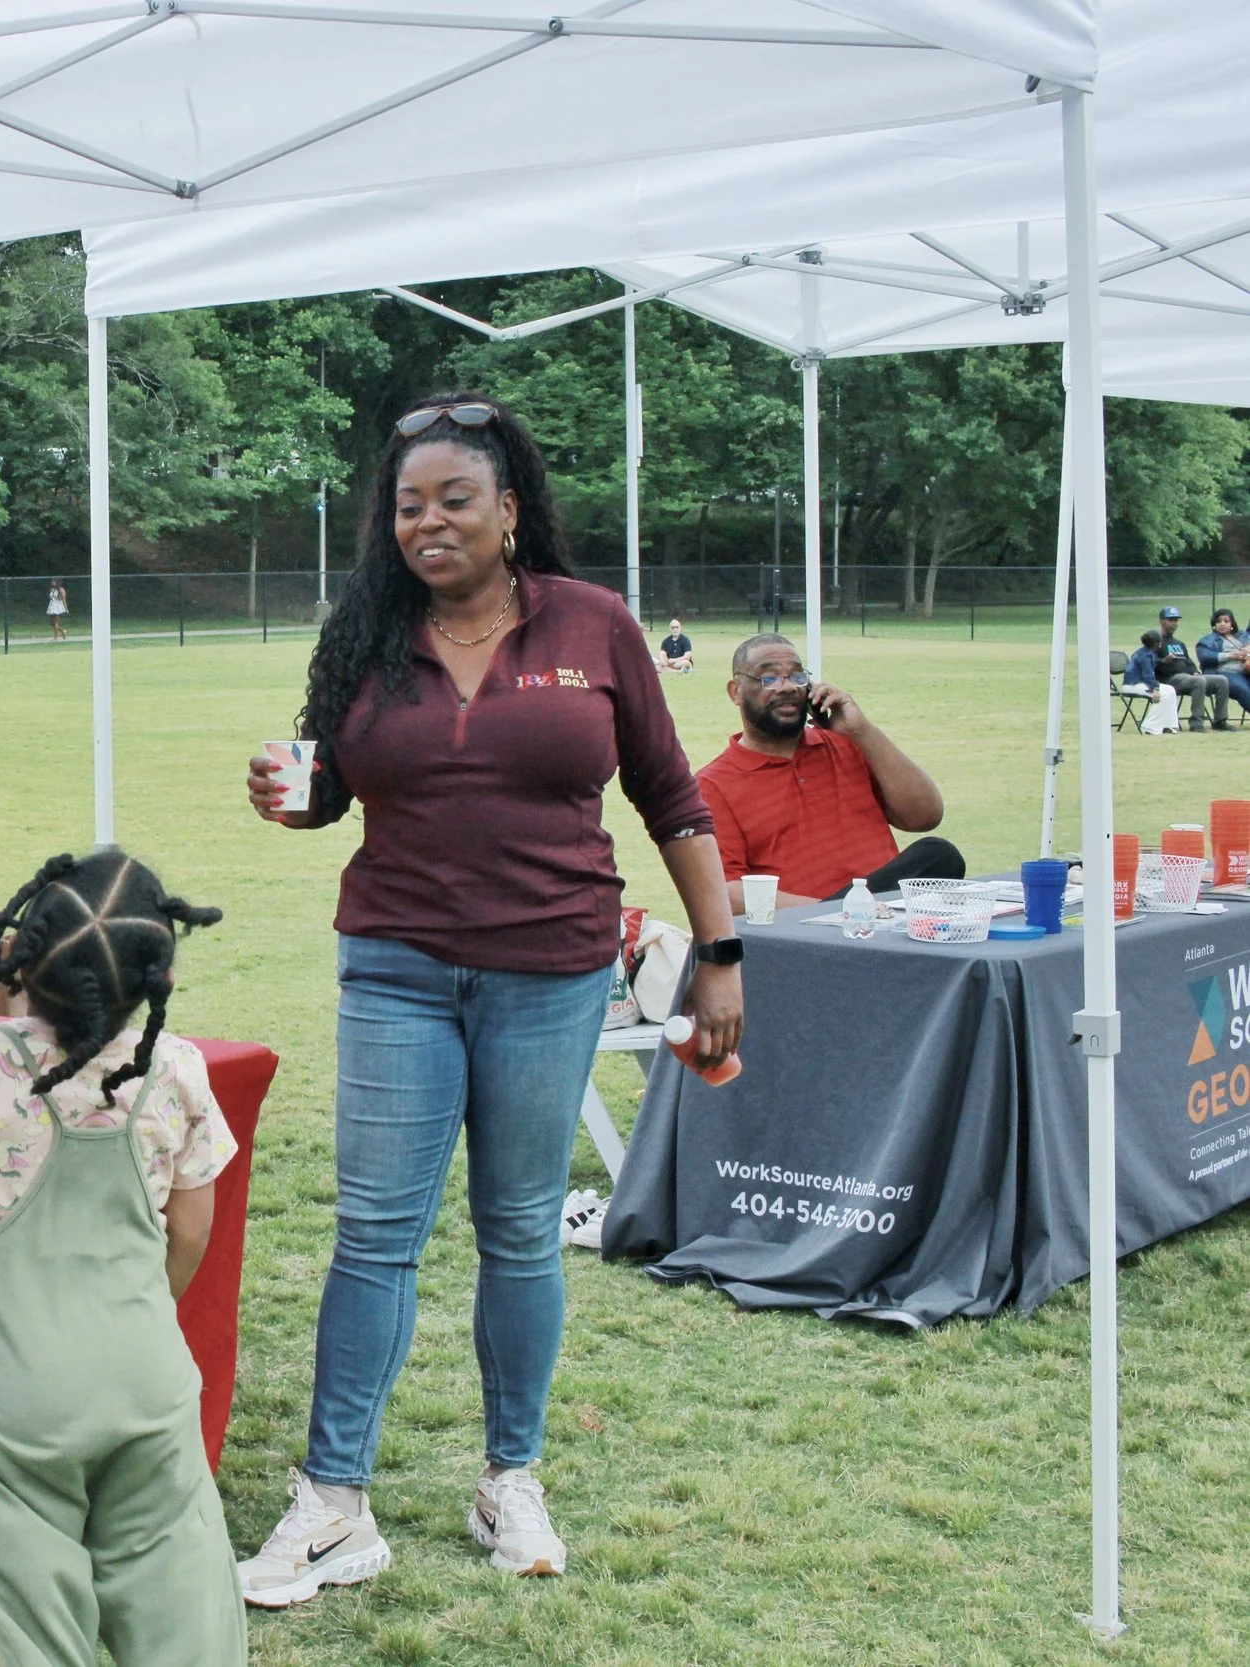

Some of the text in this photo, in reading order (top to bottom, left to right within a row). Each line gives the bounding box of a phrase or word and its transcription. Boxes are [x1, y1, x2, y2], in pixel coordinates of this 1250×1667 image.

[556, 668, 584, 679] 101.1
[558, 677, 590, 689] 100.1
[1184, 944, 1215, 962] Atlanta
[1190, 1133, 1236, 1160] Connecting
[715, 1159, 914, 1202] WorkSourceAtlanta.org
[1188, 1169, 1195, 1181] A
[730, 1191, 896, 1235] 404-546-3000
